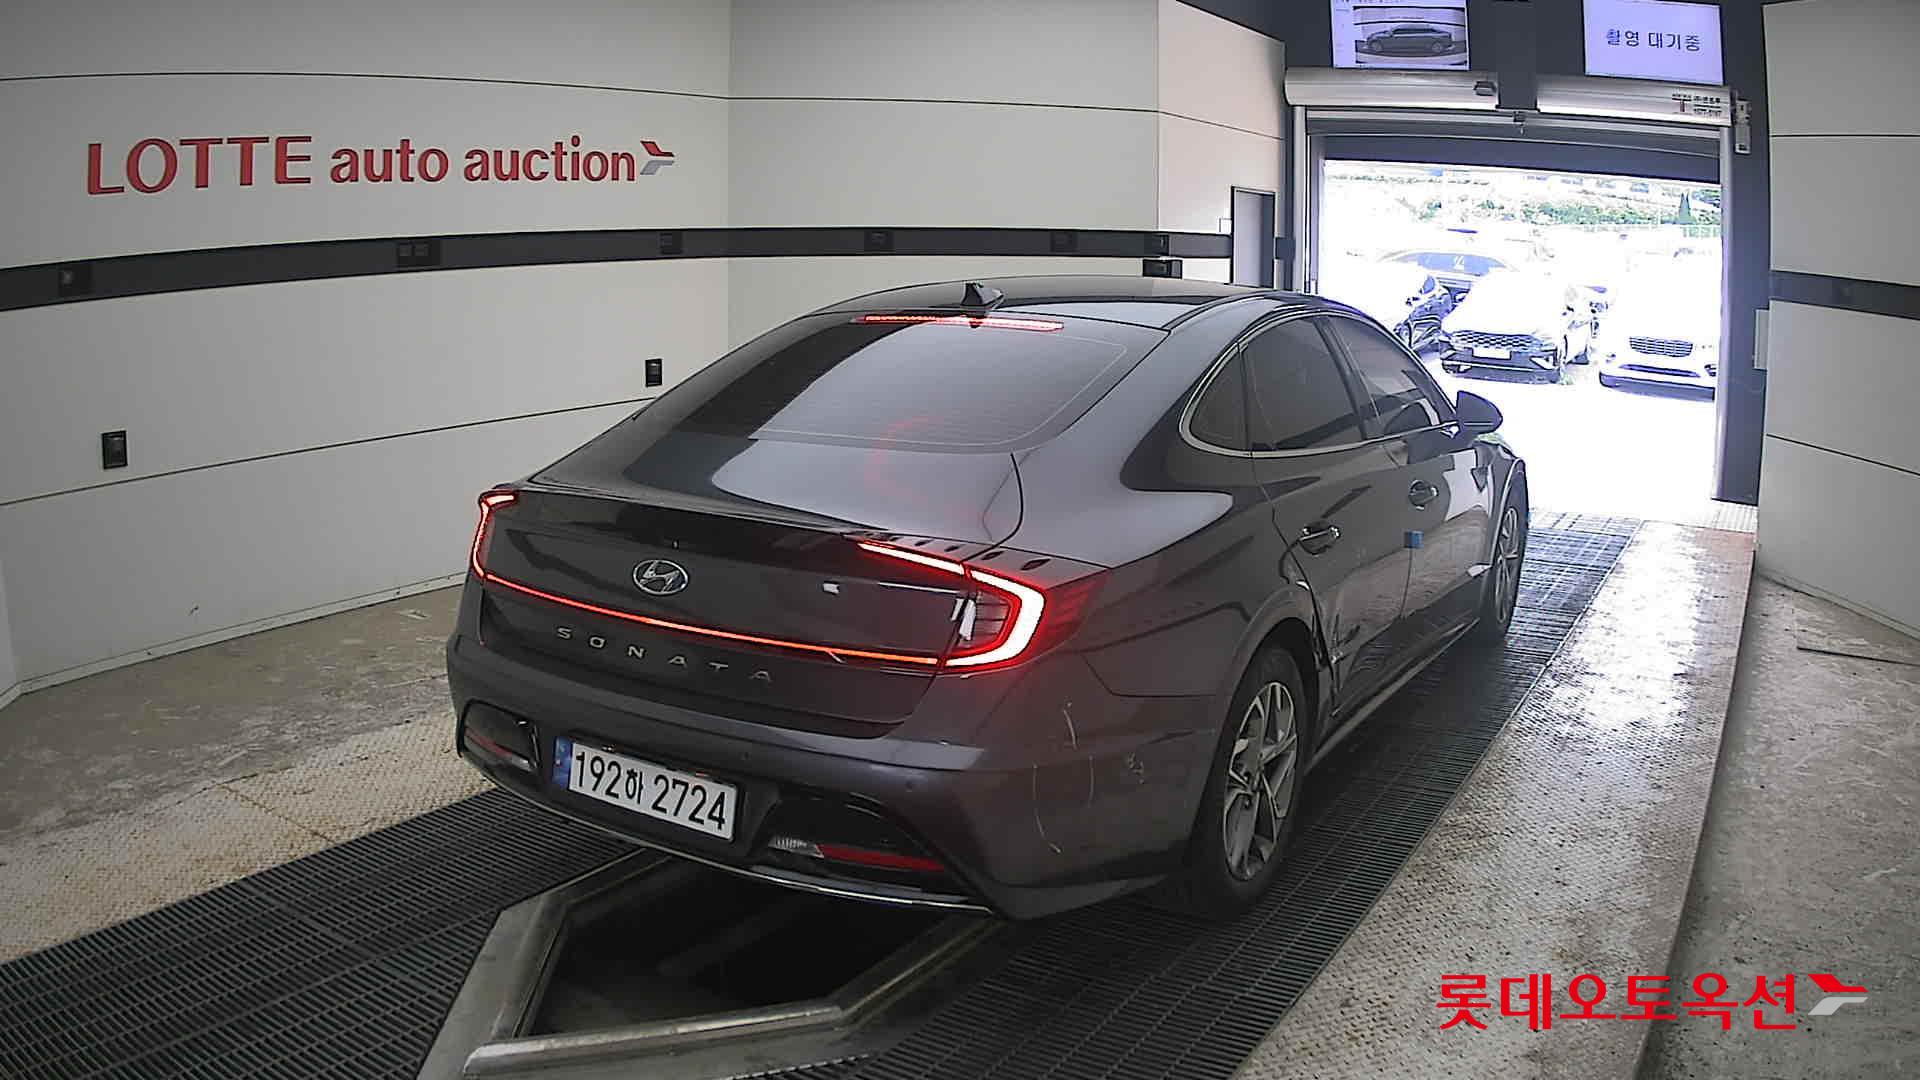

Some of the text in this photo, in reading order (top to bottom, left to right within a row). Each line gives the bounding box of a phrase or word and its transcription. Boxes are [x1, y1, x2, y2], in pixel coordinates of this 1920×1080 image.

[1606, 28, 1701, 52] 촬영 대기중
[87, 135, 636, 195] LOTTE auto auction
[556, 627, 773, 683] SONATA
[575, 751, 727, 831] 192하 2724
